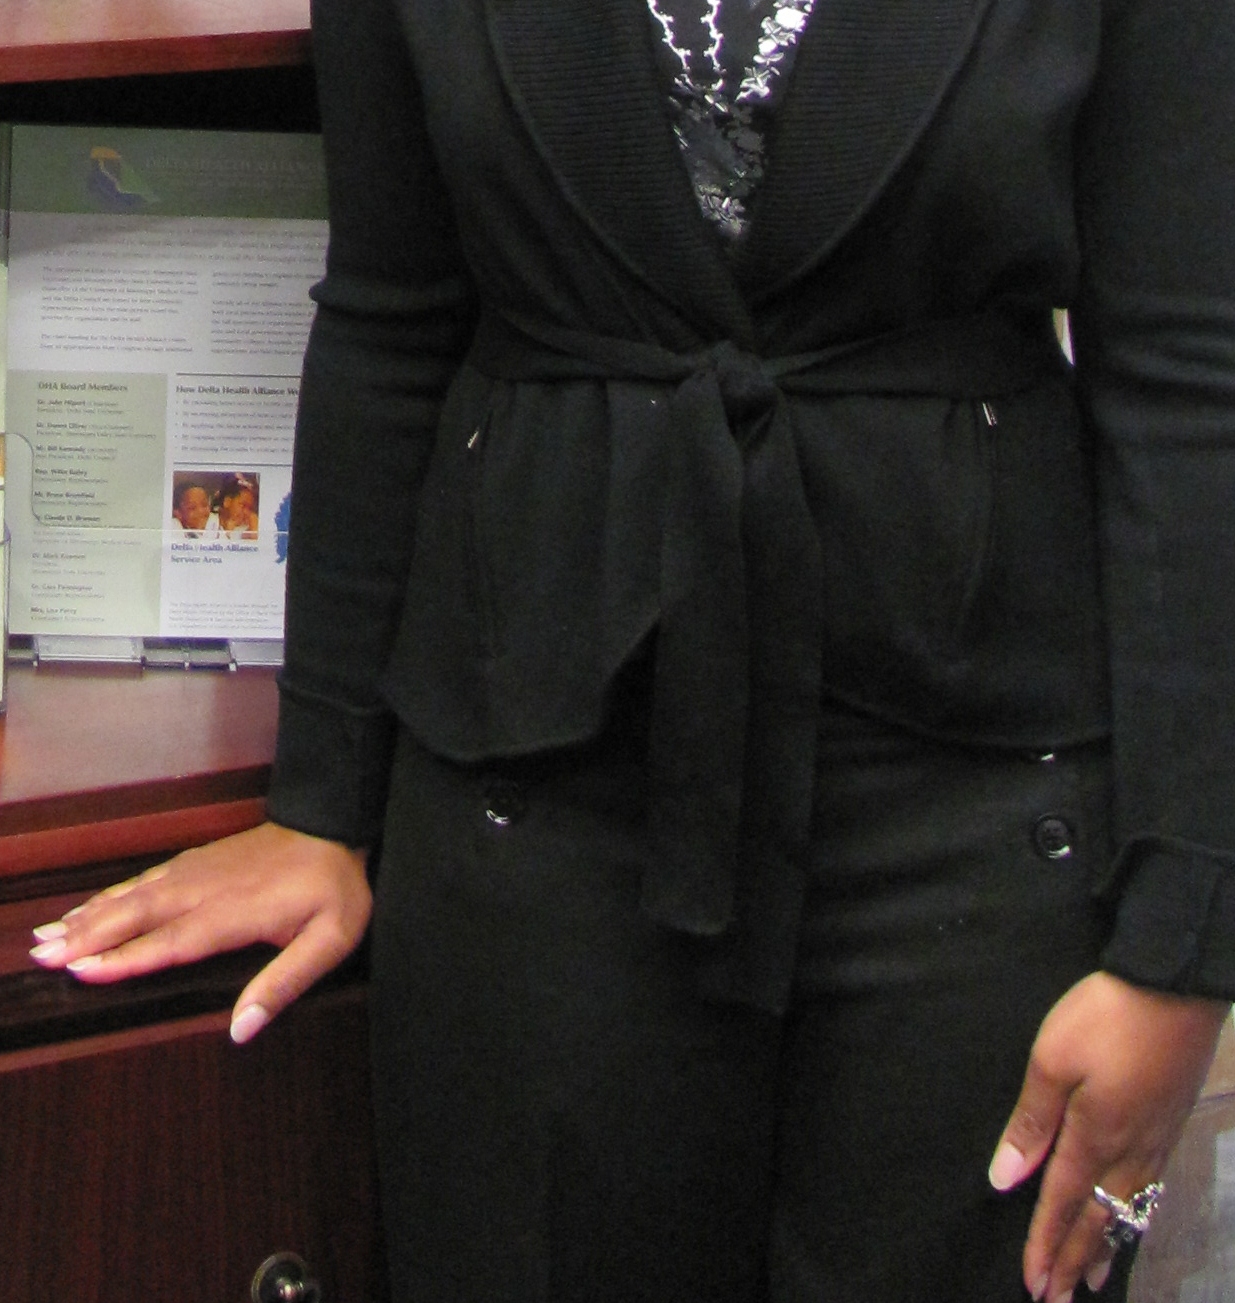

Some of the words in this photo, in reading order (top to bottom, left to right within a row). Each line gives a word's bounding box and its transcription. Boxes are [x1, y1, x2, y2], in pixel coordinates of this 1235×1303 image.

[198, 386, 220, 394] Delta
[223, 386, 250, 394] Health
[171, 543, 192, 551] Delta
[226, 544, 258, 552] Alliance
